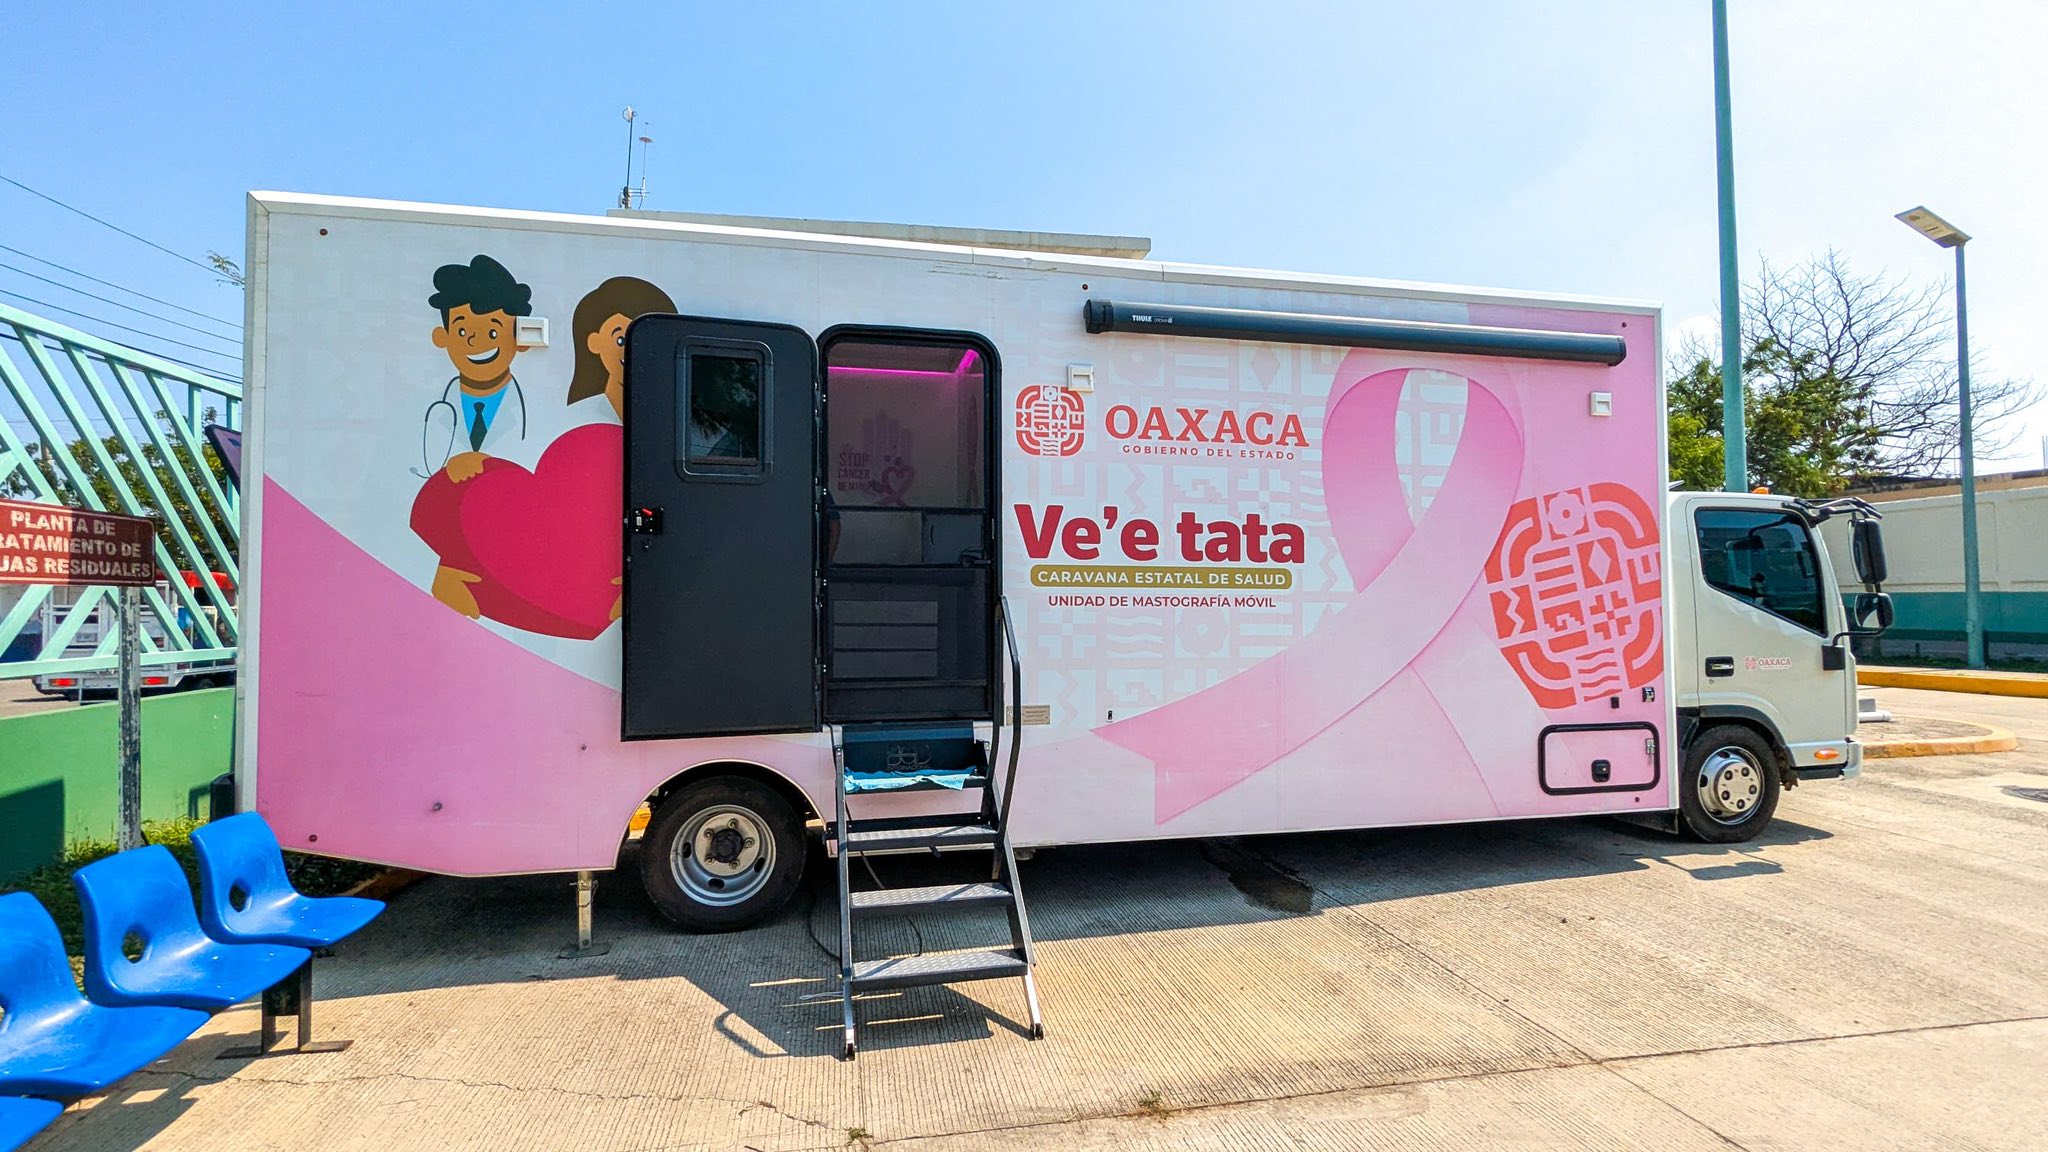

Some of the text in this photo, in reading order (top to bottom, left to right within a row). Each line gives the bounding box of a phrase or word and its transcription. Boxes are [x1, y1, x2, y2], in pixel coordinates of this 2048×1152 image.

[1105, 404, 1310, 447] OAXACA
[839, 452, 870, 467] STOP
[1122, 444, 1295, 461] GOBIERNO DEL ESTADO
[10, 510, 117, 537] PLANTA DE
[1013, 503, 1305, 564] Ve’e tata
[121, 541, 142, 558] DE
[44, 557, 151, 578] RESIDUALES
[1037, 570, 1286, 586] CARAVANA ESTATAL DE SALUD
[1048, 594, 1276, 608] UNIDAD DE MASTOGRAFÍA MÓVIL
[1758, 658, 1792, 667] OAXACA
